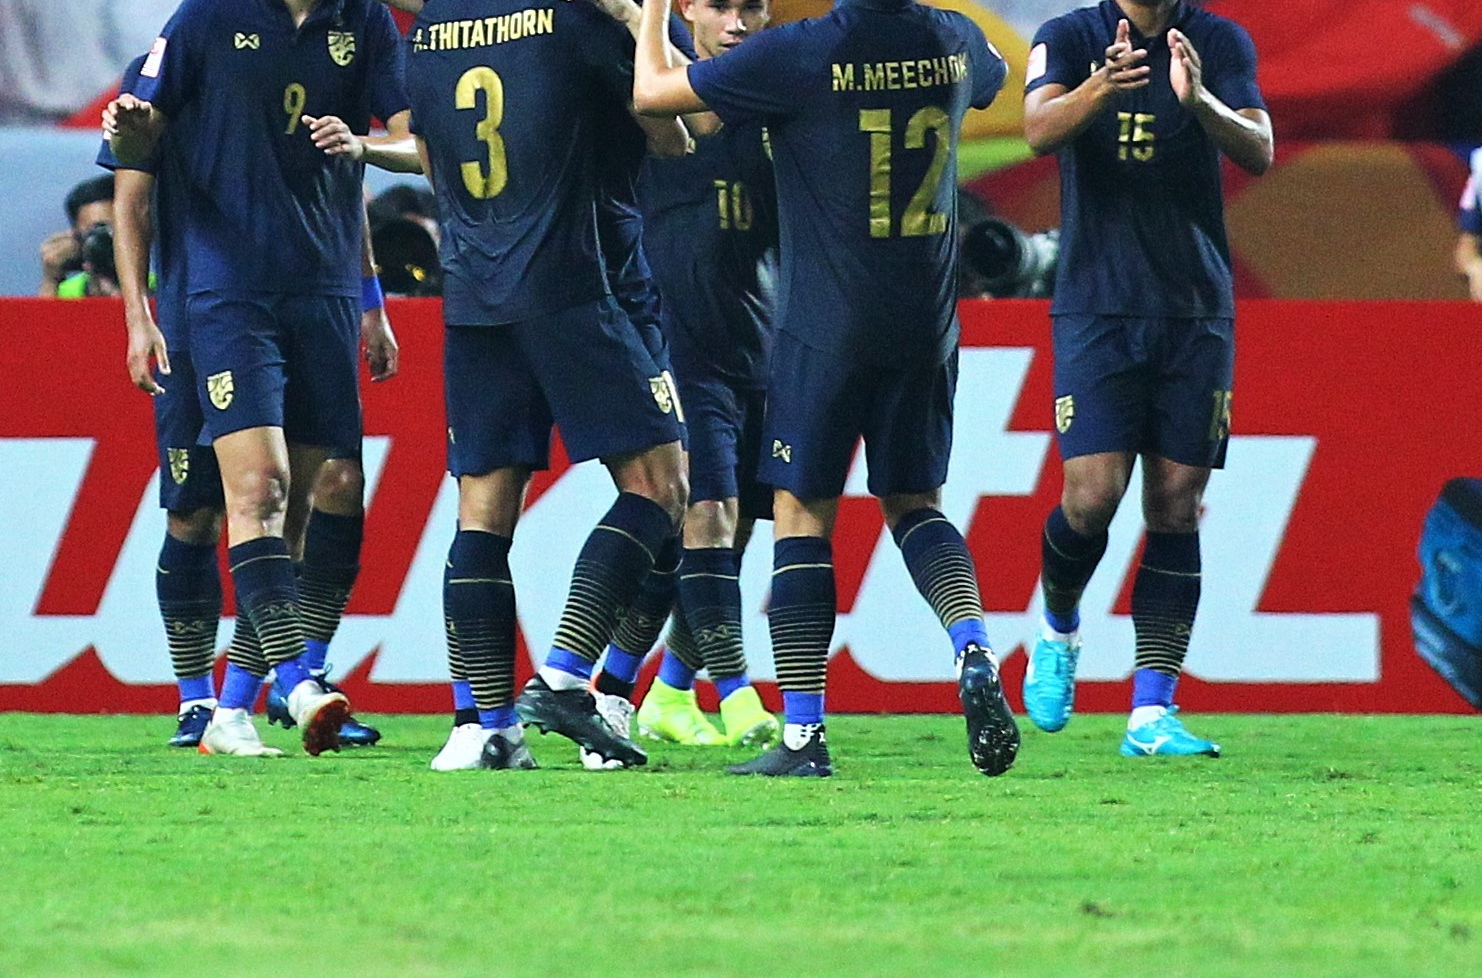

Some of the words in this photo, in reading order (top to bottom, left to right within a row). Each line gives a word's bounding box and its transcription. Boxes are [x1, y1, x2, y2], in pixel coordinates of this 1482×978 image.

[284, 82, 306, 135] 9
[455, 66, 508, 199] 3
[1117, 111, 1156, 162] 15
[859, 105, 952, 238] 12
[713, 179, 753, 231] 10
